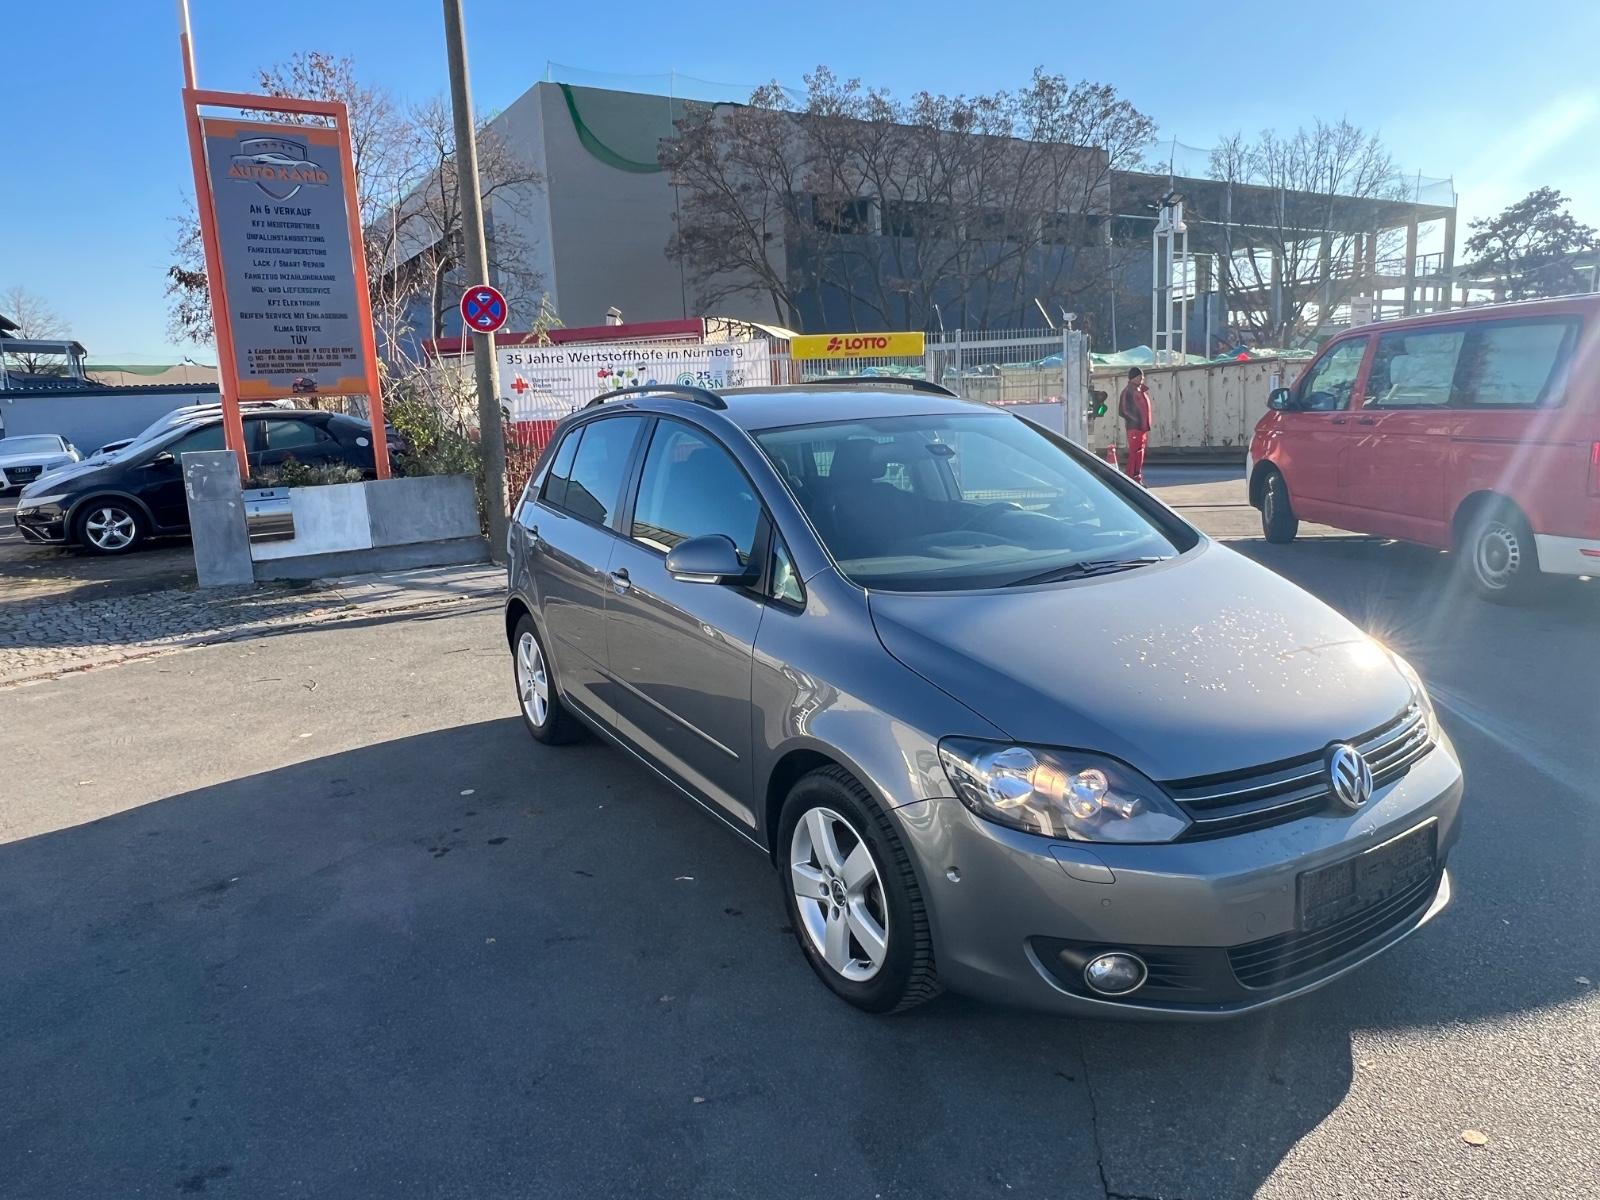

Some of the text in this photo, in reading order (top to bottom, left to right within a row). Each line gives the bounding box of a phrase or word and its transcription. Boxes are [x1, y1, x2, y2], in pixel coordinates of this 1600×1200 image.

[228, 163, 275, 180] AUTO
[273, 206, 312, 217] VERKAUF
[290, 334, 308, 345] TÜV
[844, 337, 888, 350] LOTTO
[506, 347, 744, 365] 35 Jahre Wertstoffhöfe in Nürnberg
[696, 371, 711, 380] 25
[698, 379, 724, 389] ASN
